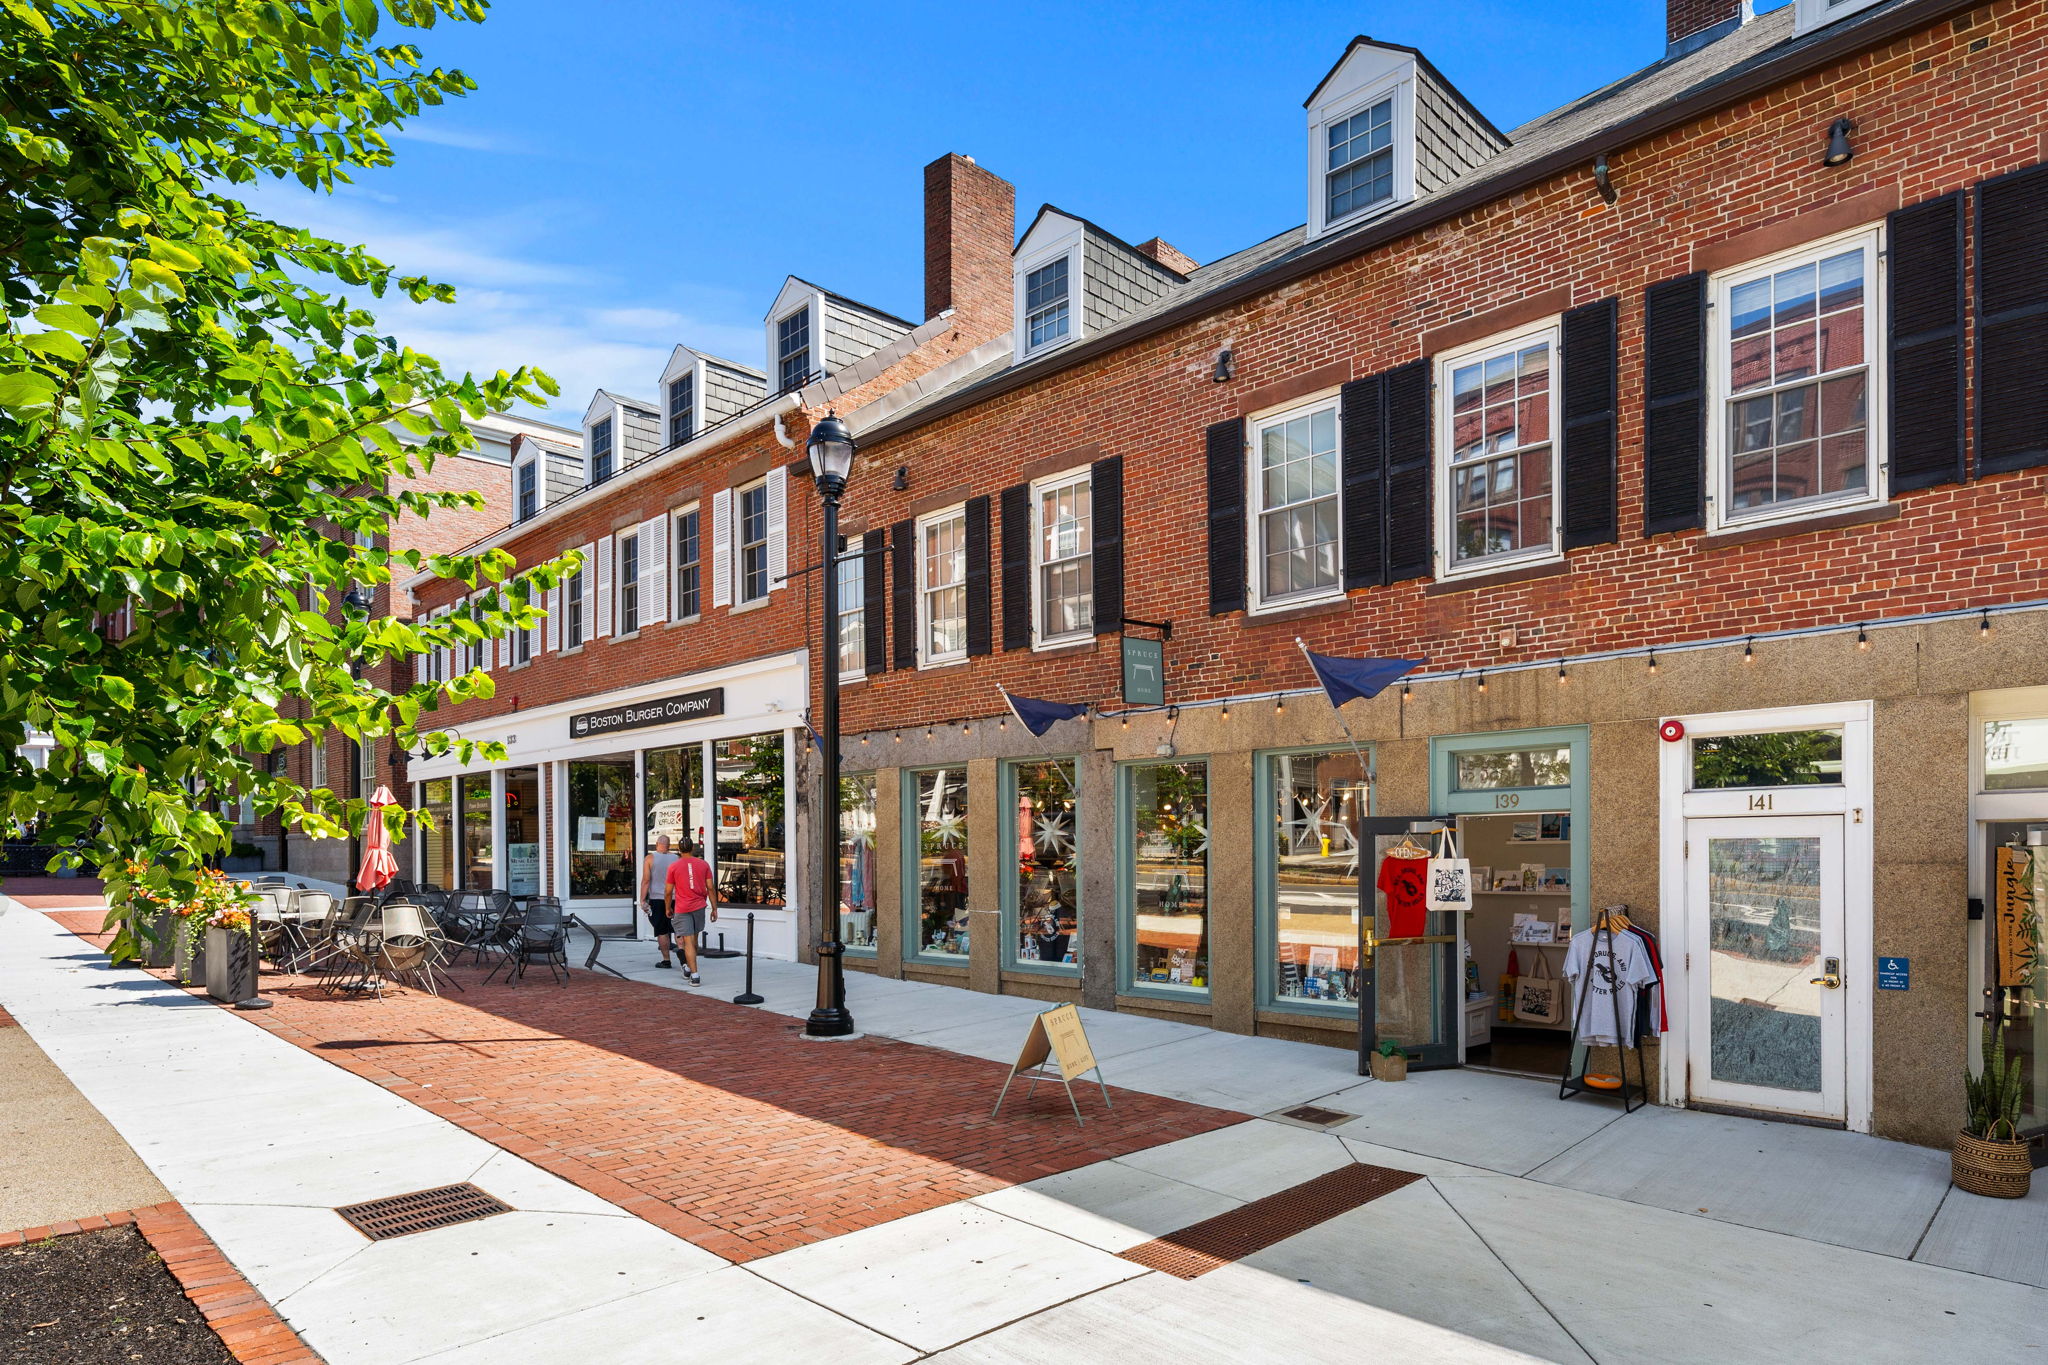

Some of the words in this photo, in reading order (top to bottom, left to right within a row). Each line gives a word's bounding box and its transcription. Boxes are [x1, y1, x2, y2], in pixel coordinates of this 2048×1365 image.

[1127, 649, 1159, 659] SPRUCE
[590, 713, 623, 729] BOSTON
[626, 707, 663, 723] BURGER
[665, 697, 711, 715] COMPANY
[1495, 793, 1520, 809] 139
[1748, 793, 1773, 811] 141
[924, 842, 964, 850] SPRUCE
[1395, 847, 1413, 859] OPEN
[2003, 857, 2019, 924] Jungle
[1617, 958, 1627, 972] AND
[1609, 980, 1626, 995] RLLS
[1050, 1011, 1074, 1026] SPRUCE
